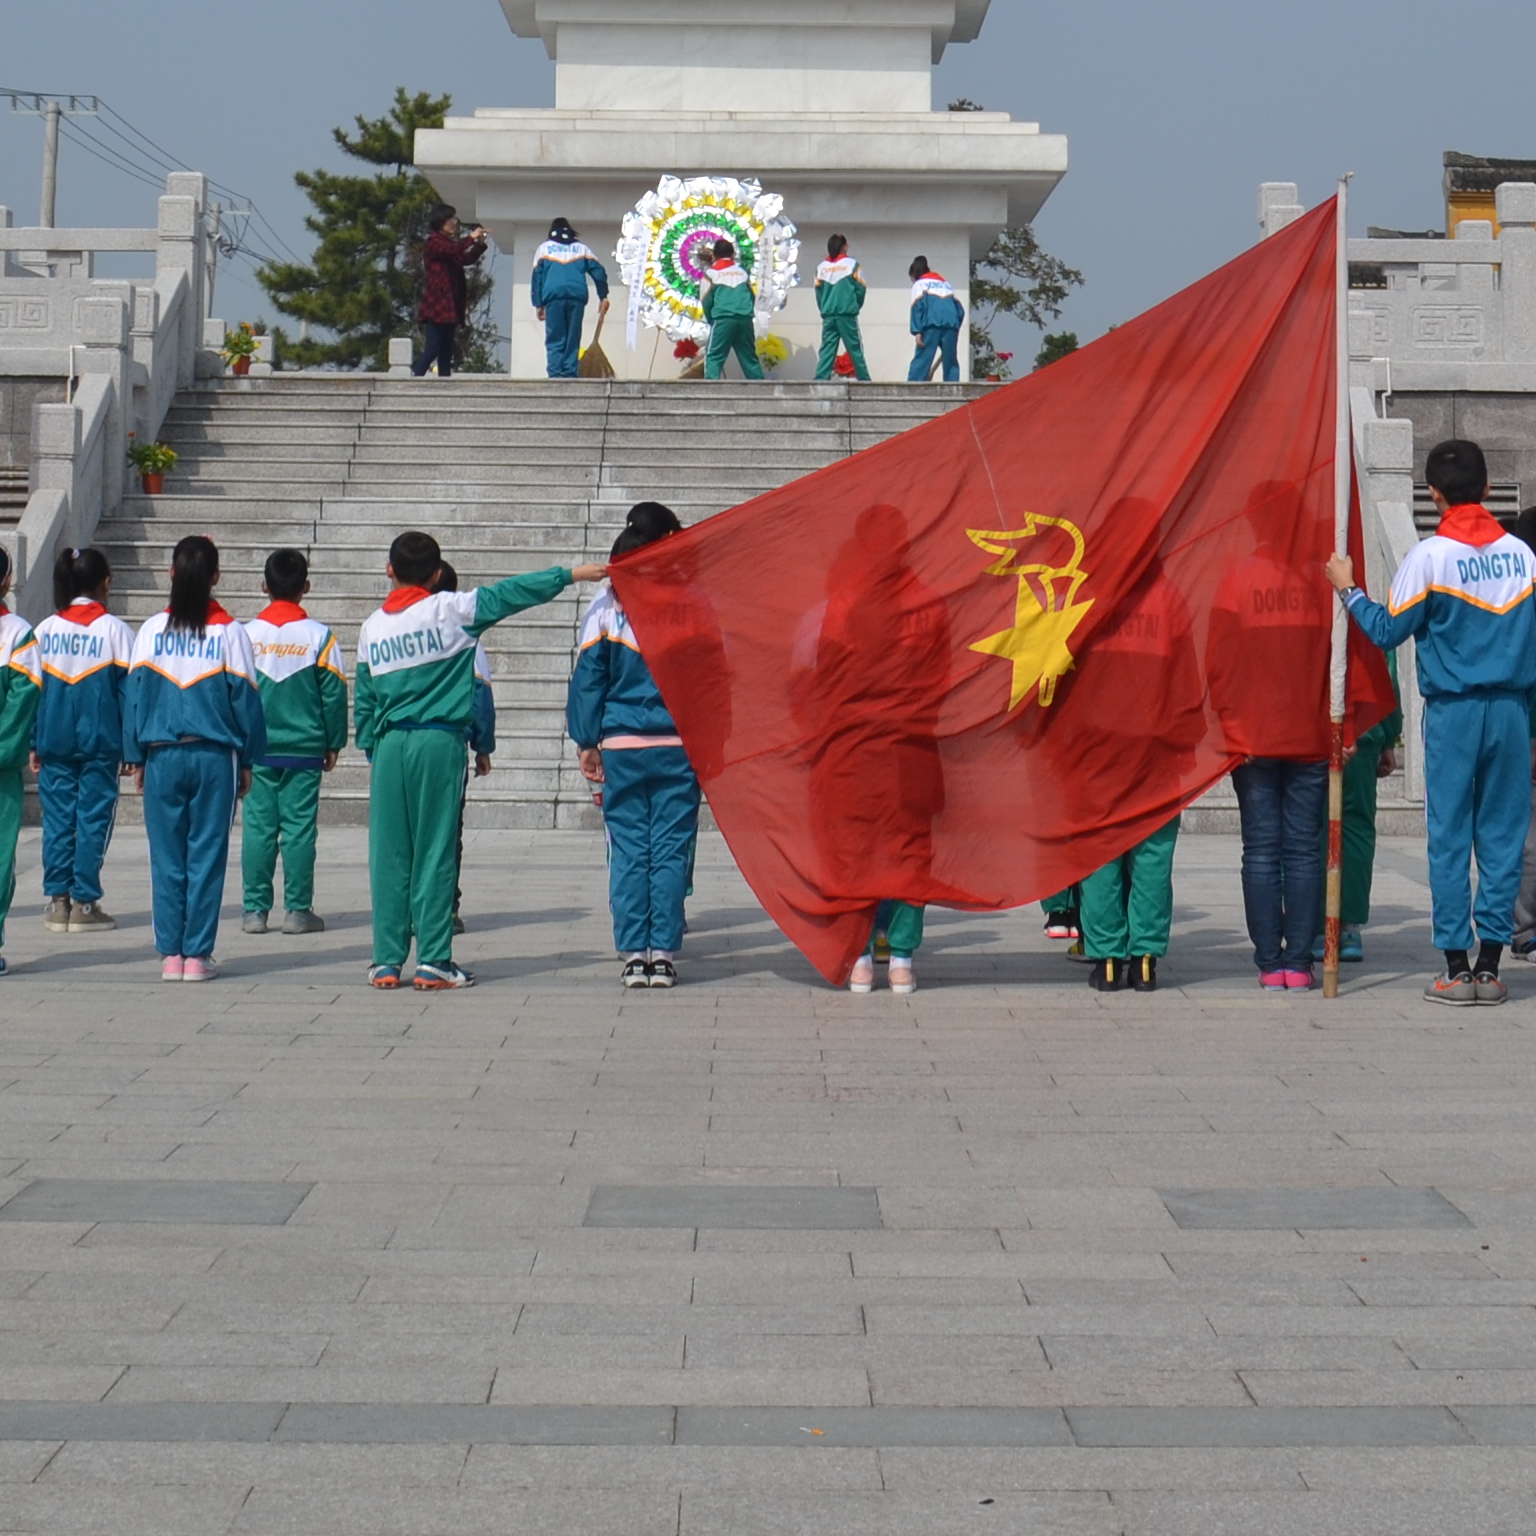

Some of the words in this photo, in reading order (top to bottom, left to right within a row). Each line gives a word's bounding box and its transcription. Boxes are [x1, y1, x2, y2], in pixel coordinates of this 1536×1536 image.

[1456, 552, 1527, 585] DONGTAI
[42, 632, 105, 660] DONGTAI
[153, 631, 222, 662] DONGTAI
[369, 627, 445, 668] DONGTAI
